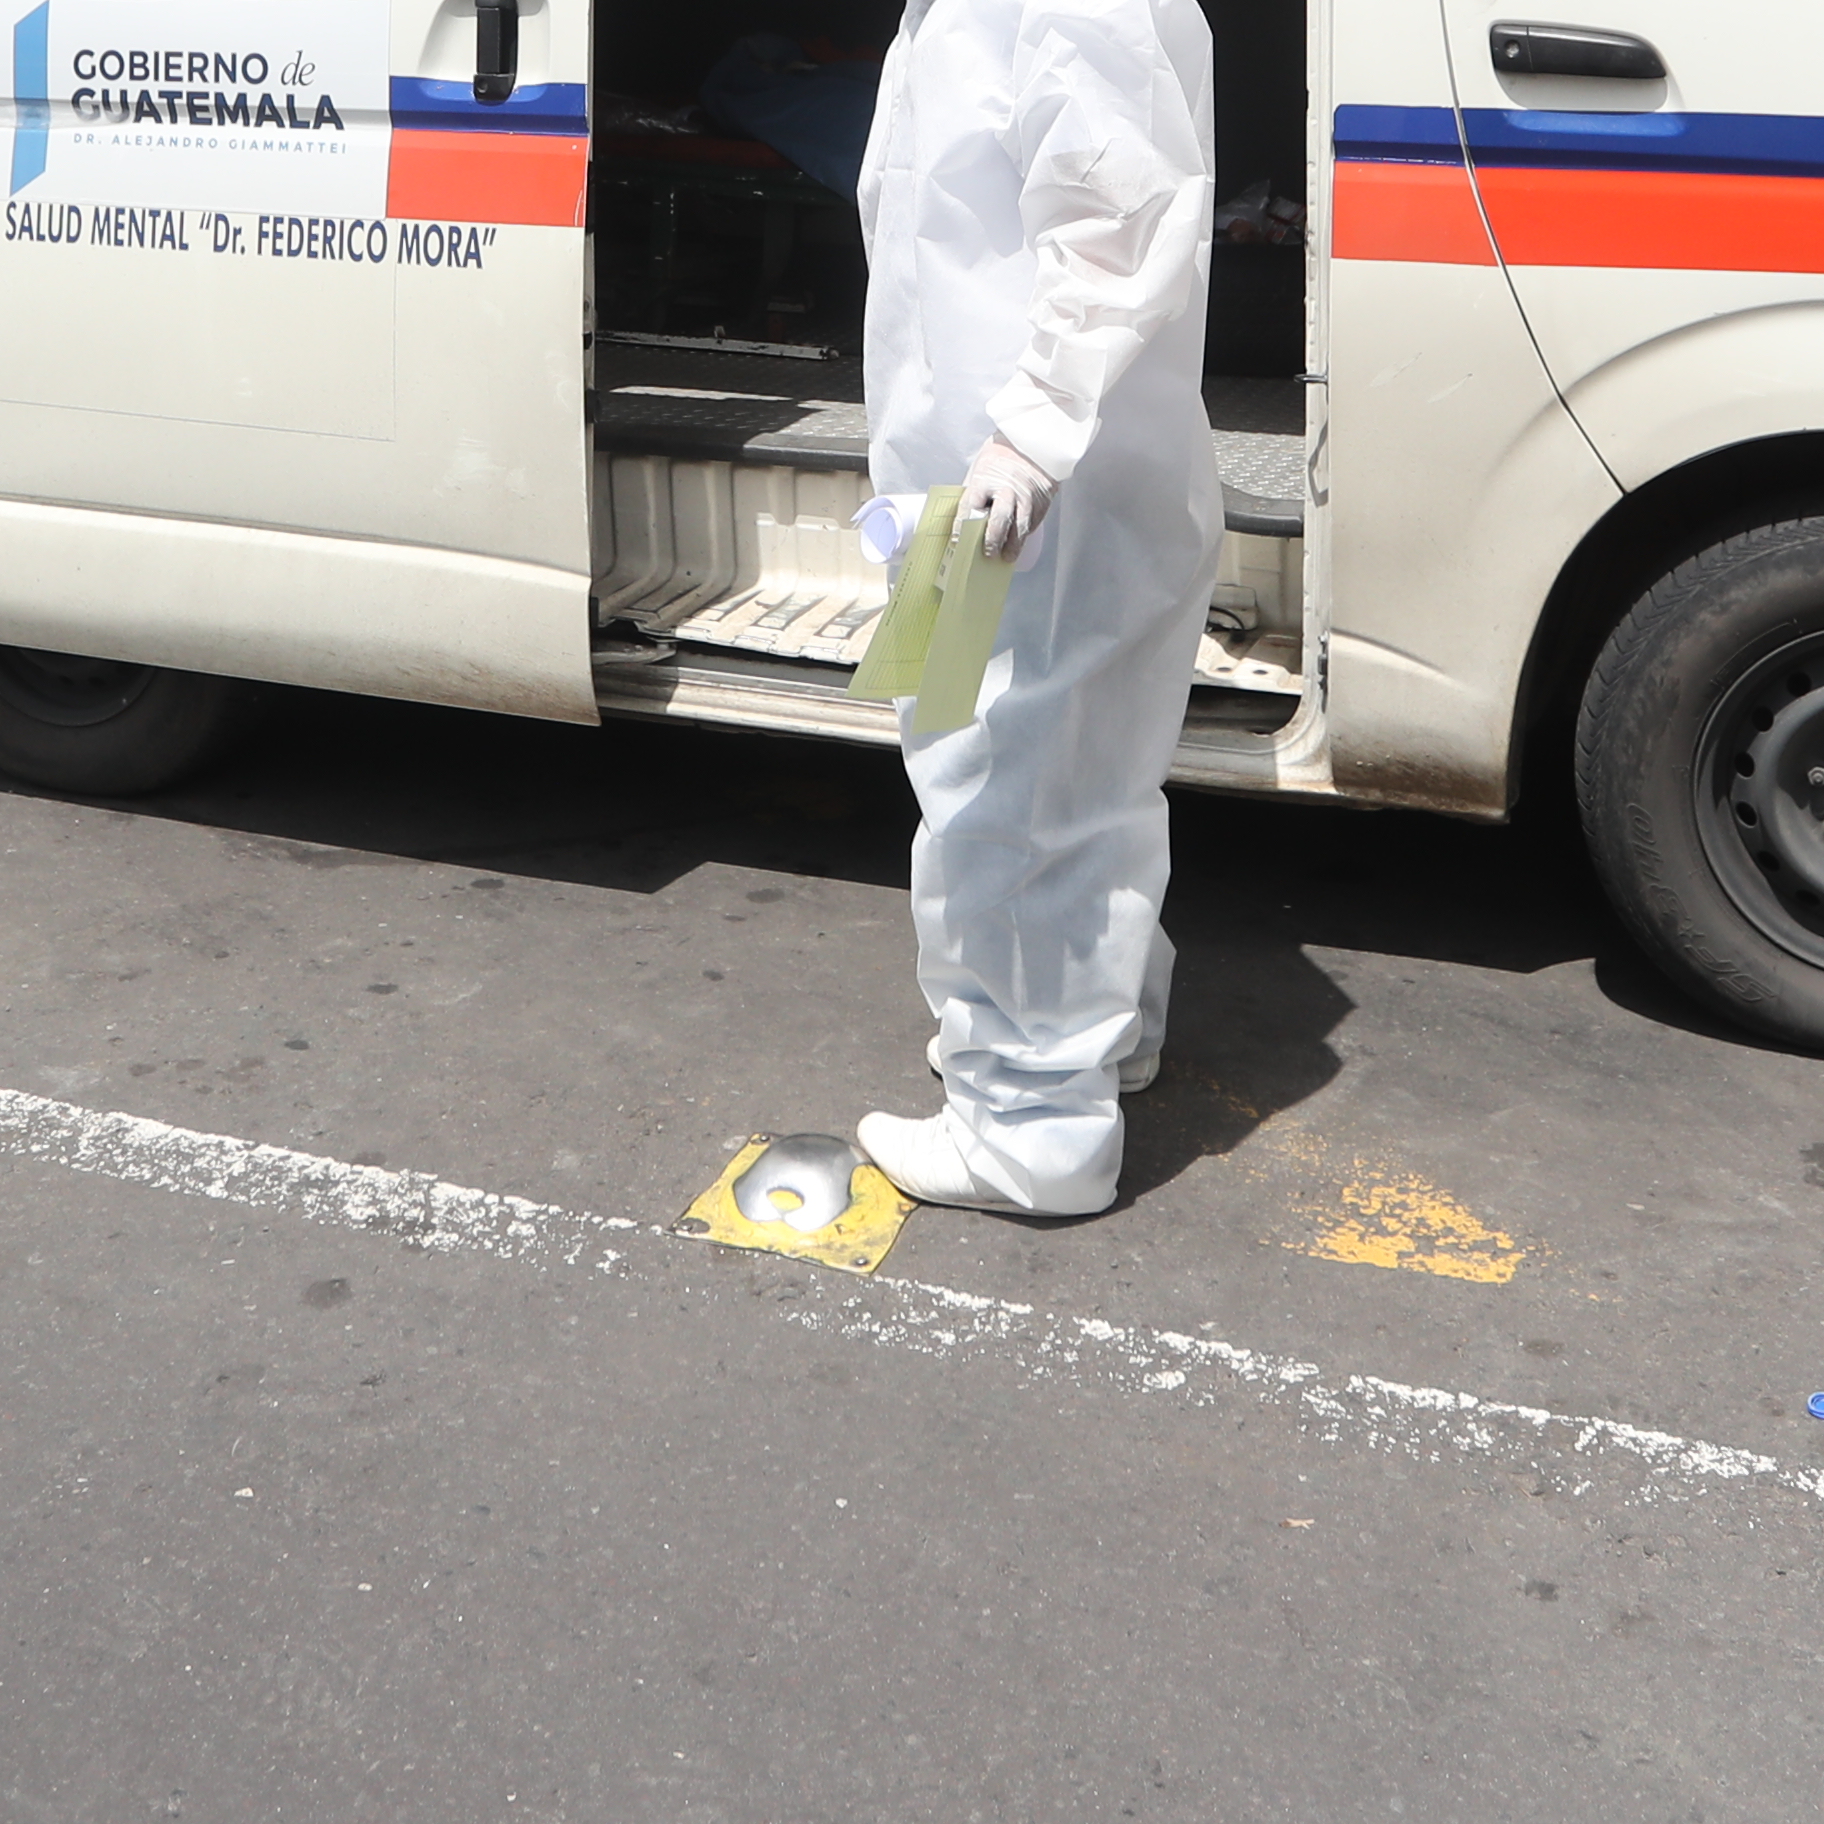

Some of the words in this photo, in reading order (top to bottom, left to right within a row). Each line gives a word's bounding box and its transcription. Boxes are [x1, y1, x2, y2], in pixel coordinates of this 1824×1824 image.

[72, 48, 270, 86] GOBIERNO
[280, 50, 316, 87] de
[70, 86, 346, 132] GUATEMALA
[73, 132, 102, 145] DR.
[111, 134, 219, 149] ALEJANDRO
[228, 139, 348, 155] GIAMMATTEI
[4, 201, 83, 244] SALUD
[90, 206, 190, 252] MENTAL
[256, 214, 389, 265] FEDERICO
